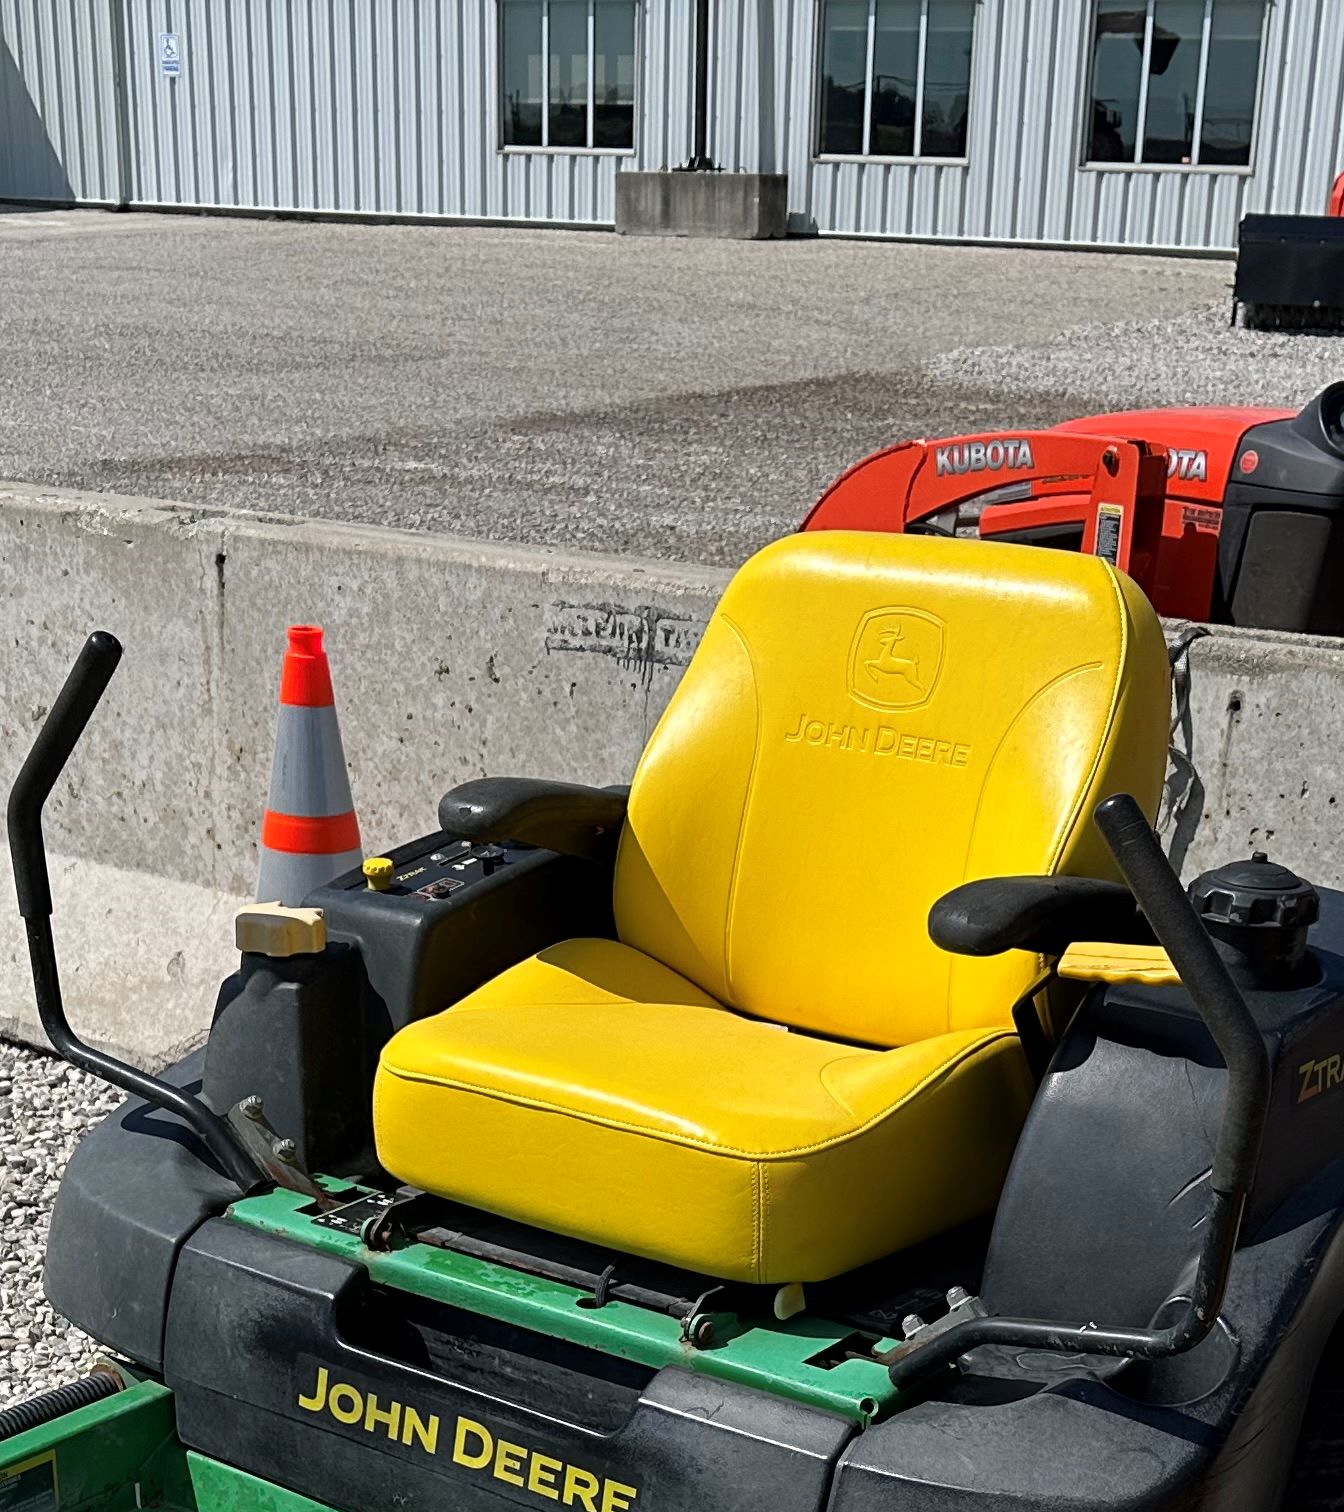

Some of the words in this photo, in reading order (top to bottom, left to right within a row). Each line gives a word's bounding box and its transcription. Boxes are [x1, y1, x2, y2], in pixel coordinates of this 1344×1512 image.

[935, 439, 1034, 477] KUBOTA
[784, 714, 869, 753] JOHN
[873, 725, 972, 769] DEERE
[298, 1366, 440, 1455] JOHN
